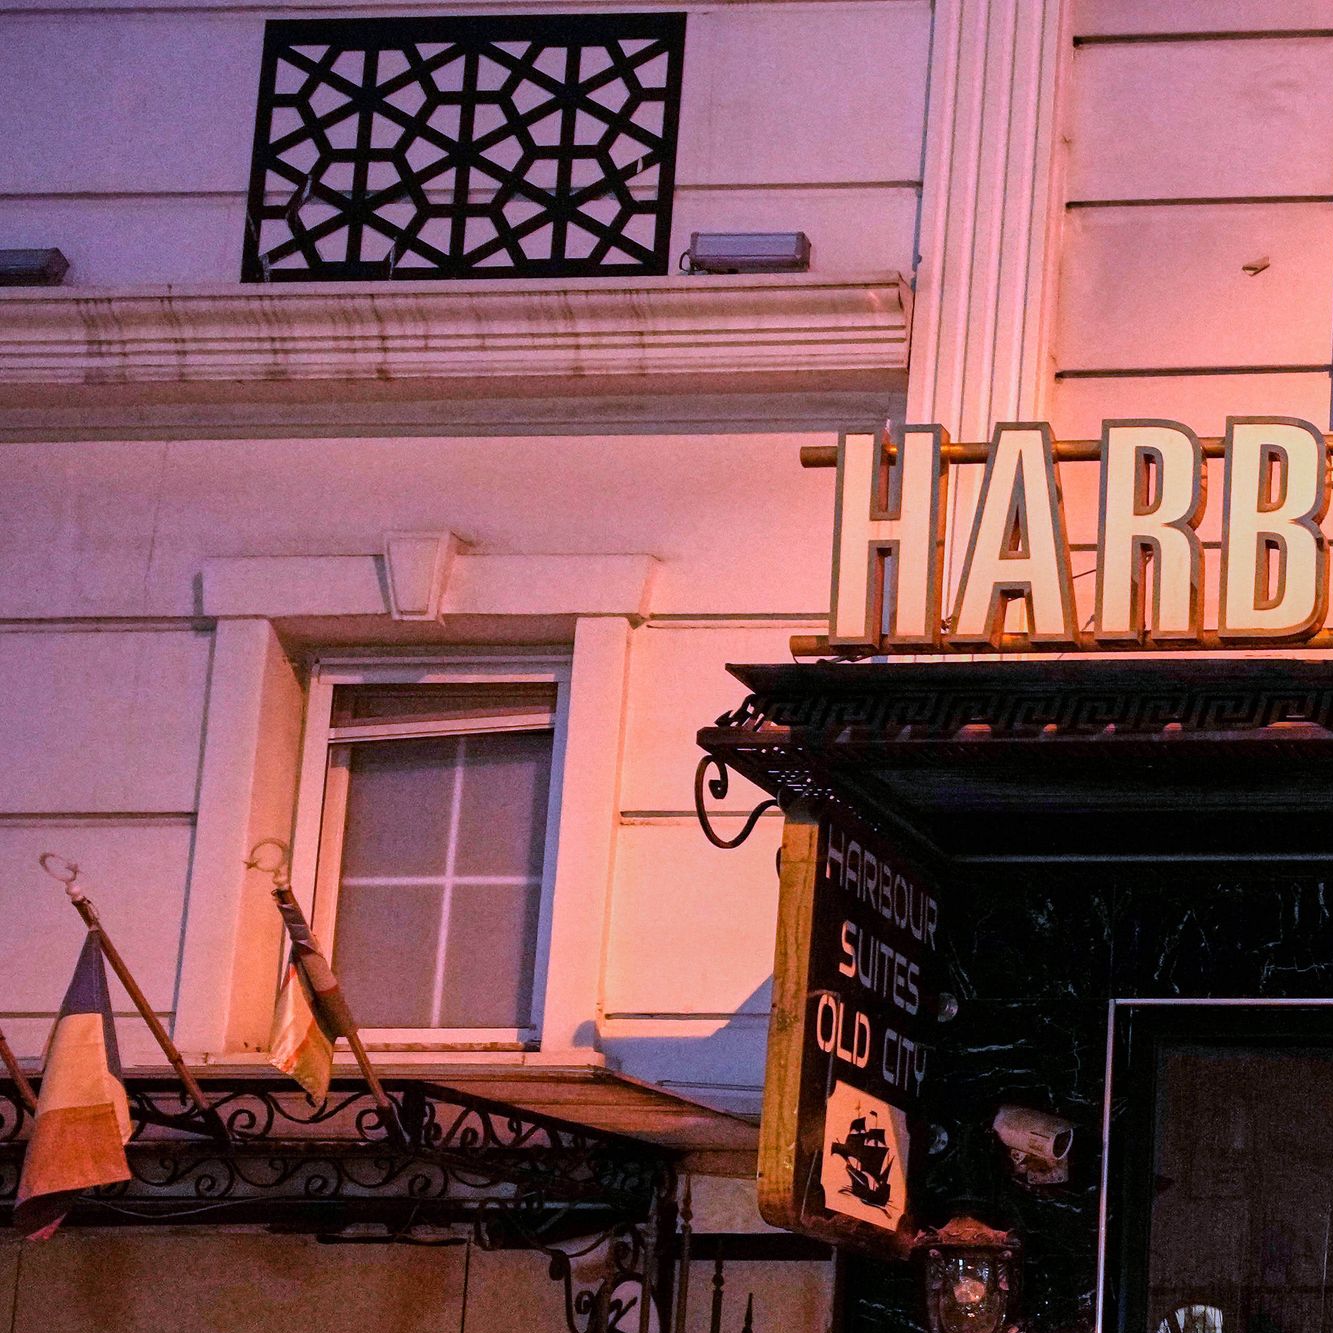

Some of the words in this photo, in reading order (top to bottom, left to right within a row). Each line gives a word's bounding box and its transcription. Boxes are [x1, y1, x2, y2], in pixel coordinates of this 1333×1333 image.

[826, 823, 938, 951] HARBOUR
[838, 919, 920, 1015] SUITES
[816, 993, 871, 1069] OLD
[882, 1028, 928, 1098] CITY
